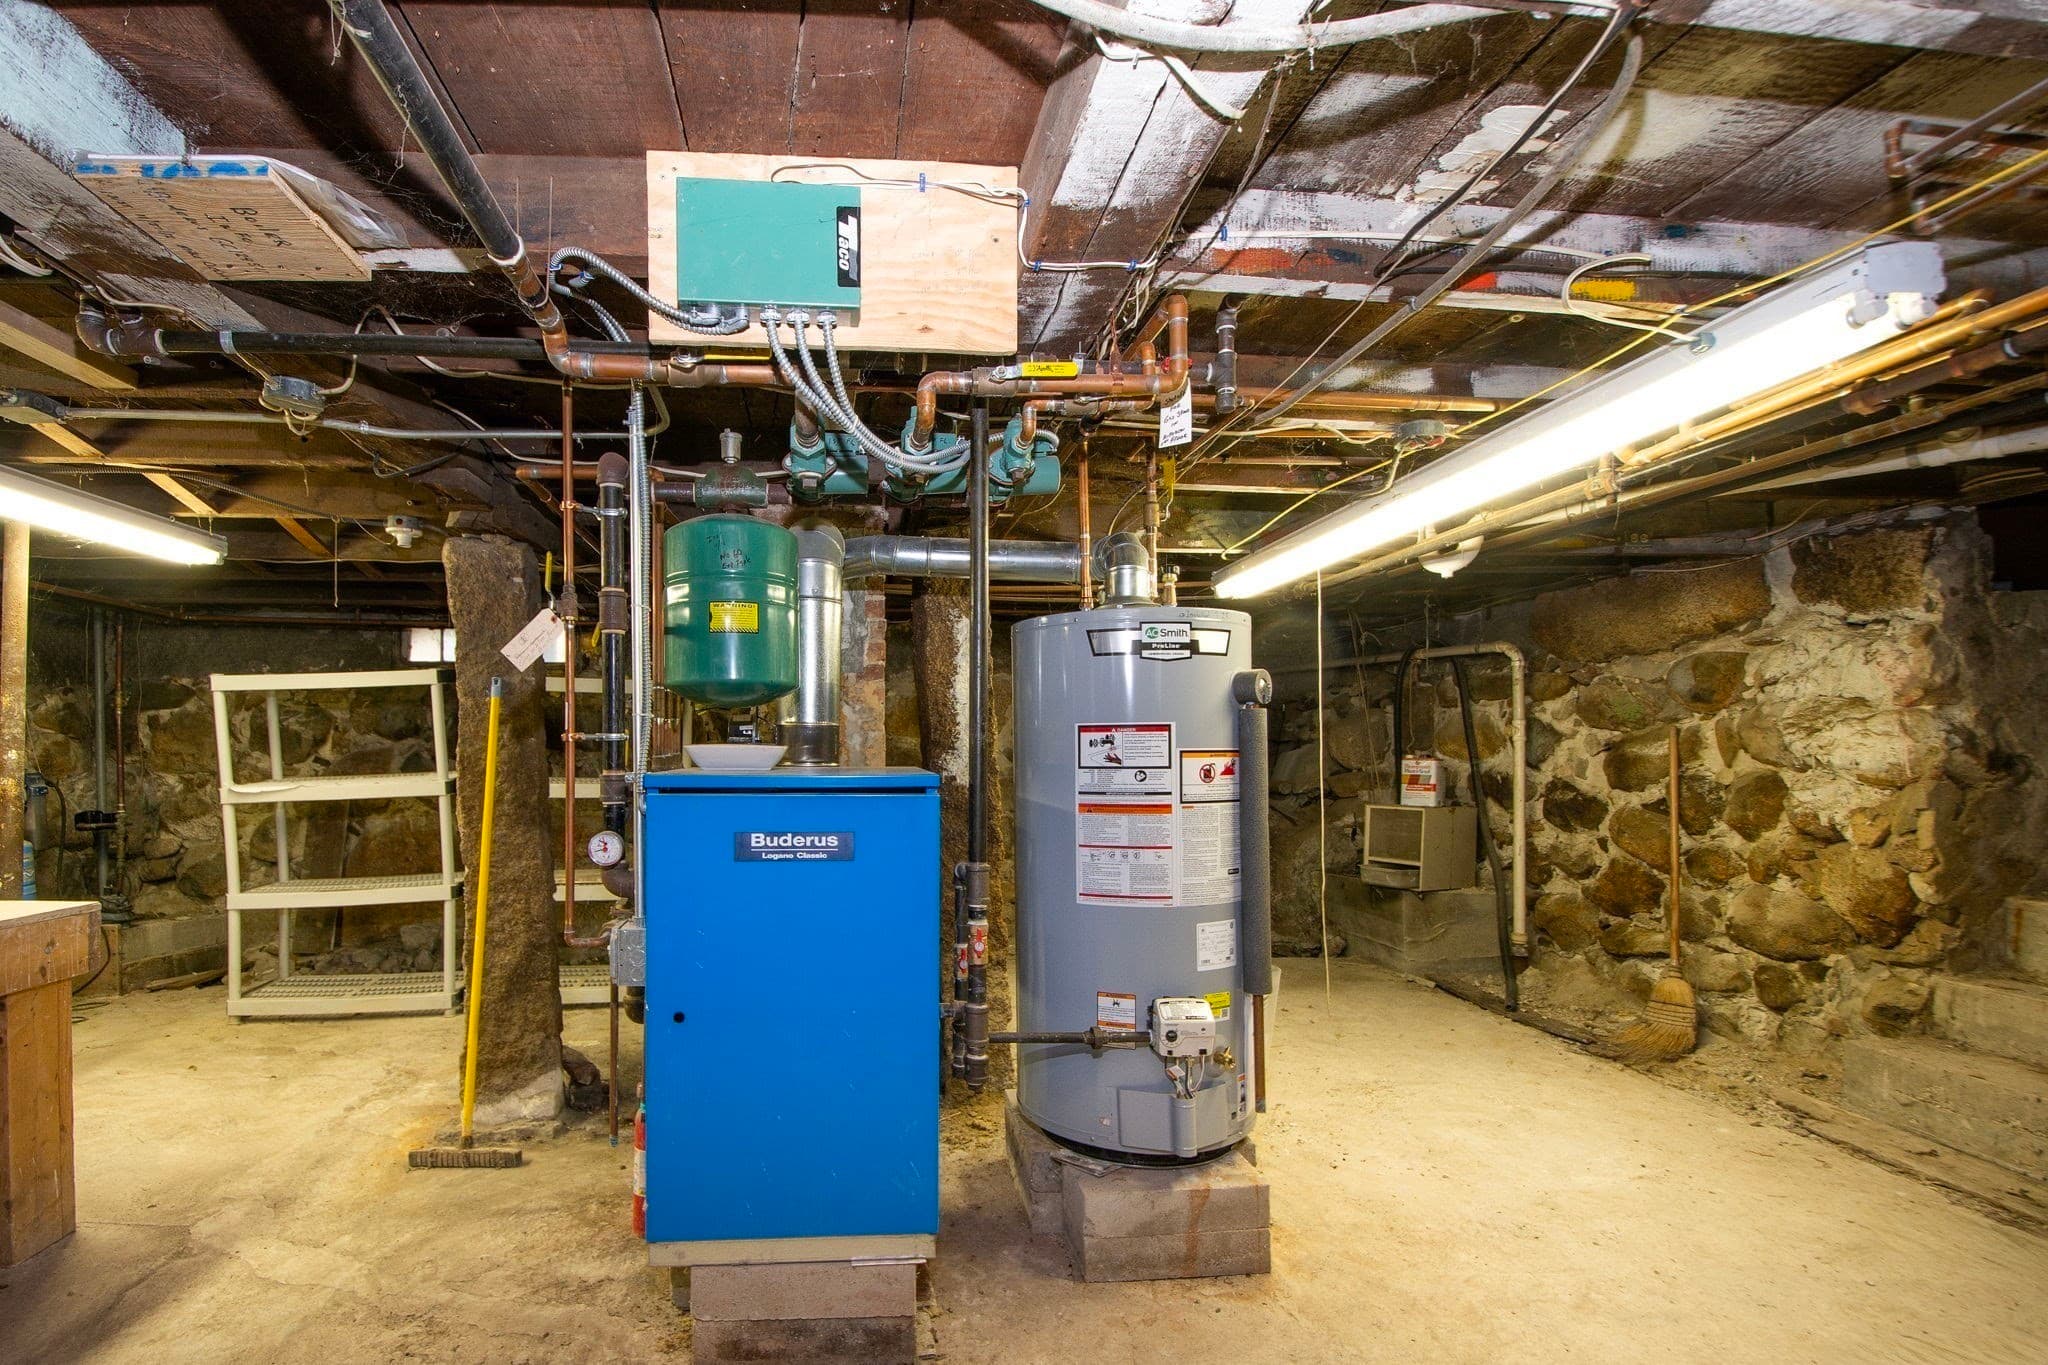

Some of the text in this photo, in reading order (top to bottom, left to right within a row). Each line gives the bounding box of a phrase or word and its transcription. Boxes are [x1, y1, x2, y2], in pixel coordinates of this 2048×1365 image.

[838, 214, 858, 271] Taco
[1160, 628, 1188, 637] Smith
[750, 833, 839, 847] Buderus
[762, 852, 794, 860] Logano
